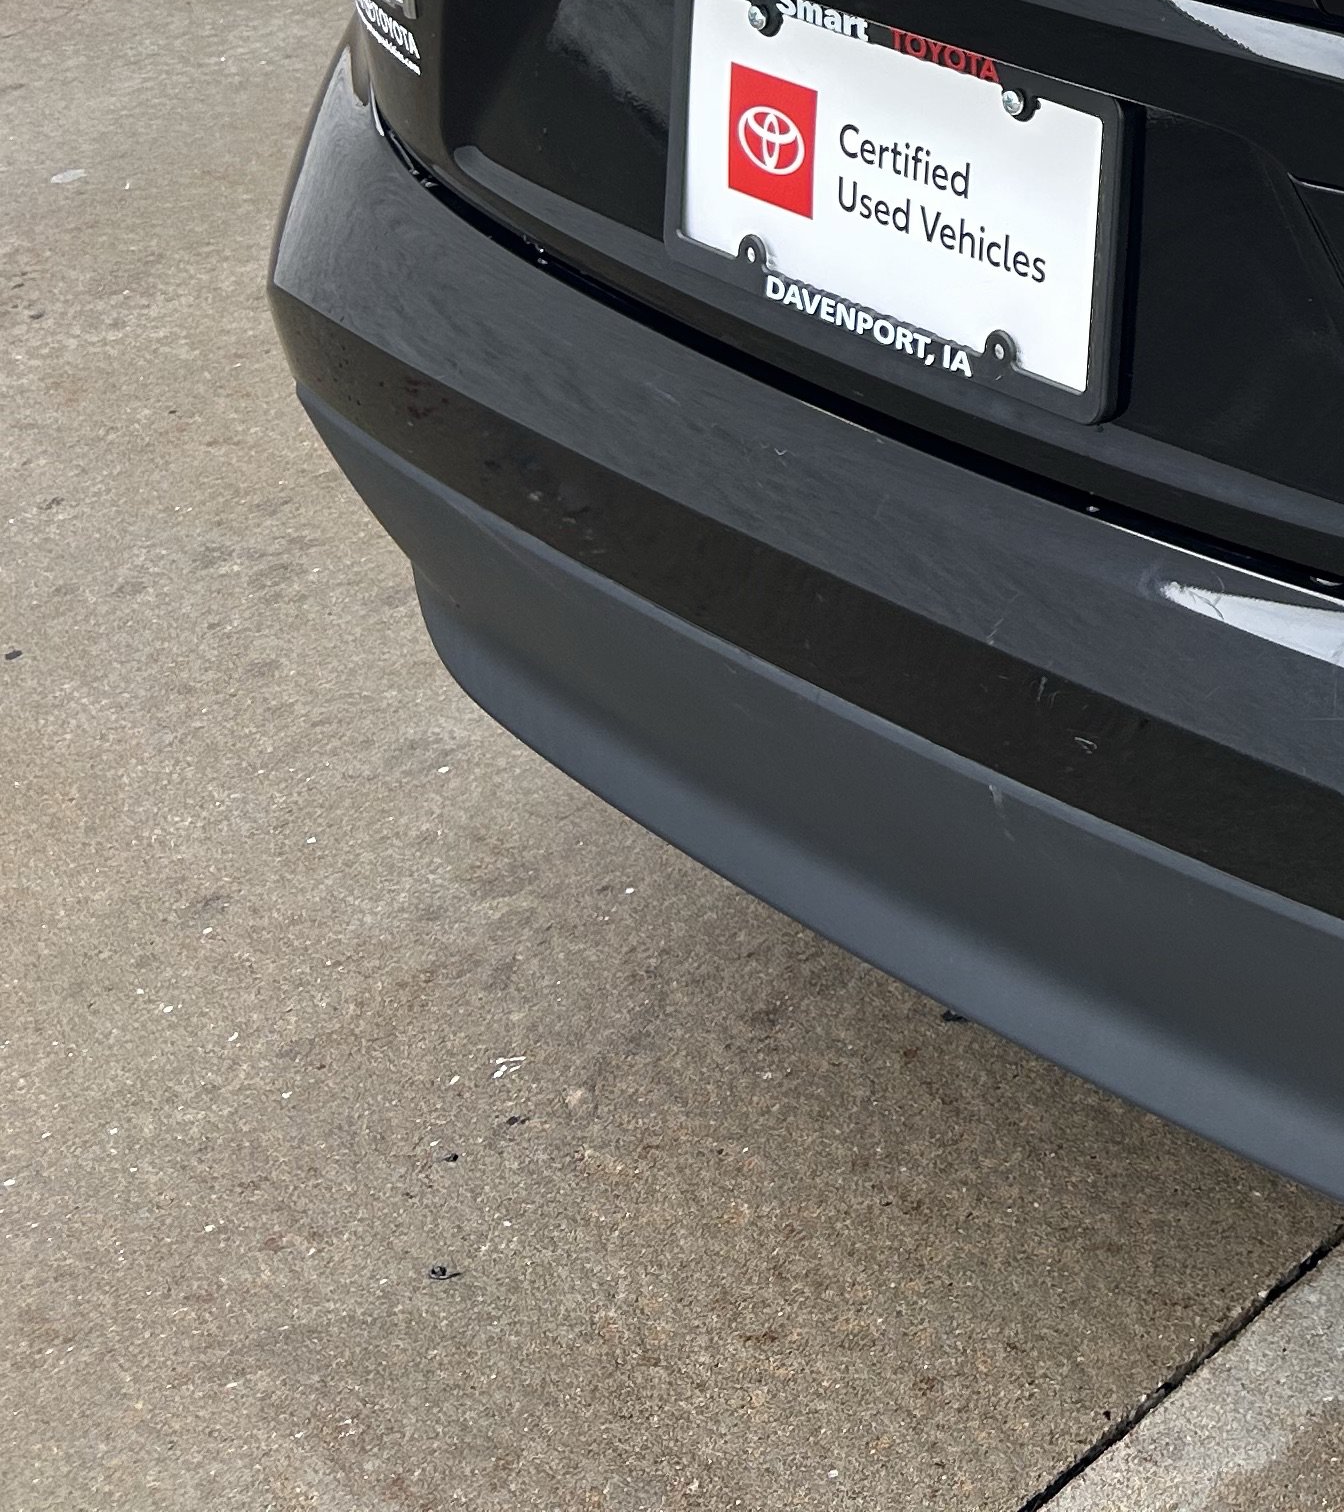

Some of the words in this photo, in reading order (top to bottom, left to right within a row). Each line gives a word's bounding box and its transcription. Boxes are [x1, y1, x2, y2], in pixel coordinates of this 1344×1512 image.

[890, 27, 1000, 83] TOYOTA
[839, 123, 971, 200] Certified
[838, 176, 911, 235] Used
[919, 204, 1047, 284] Vehicles
[765, 274, 936, 366] DAVENPORT,
[942, 344, 973, 378] IA
